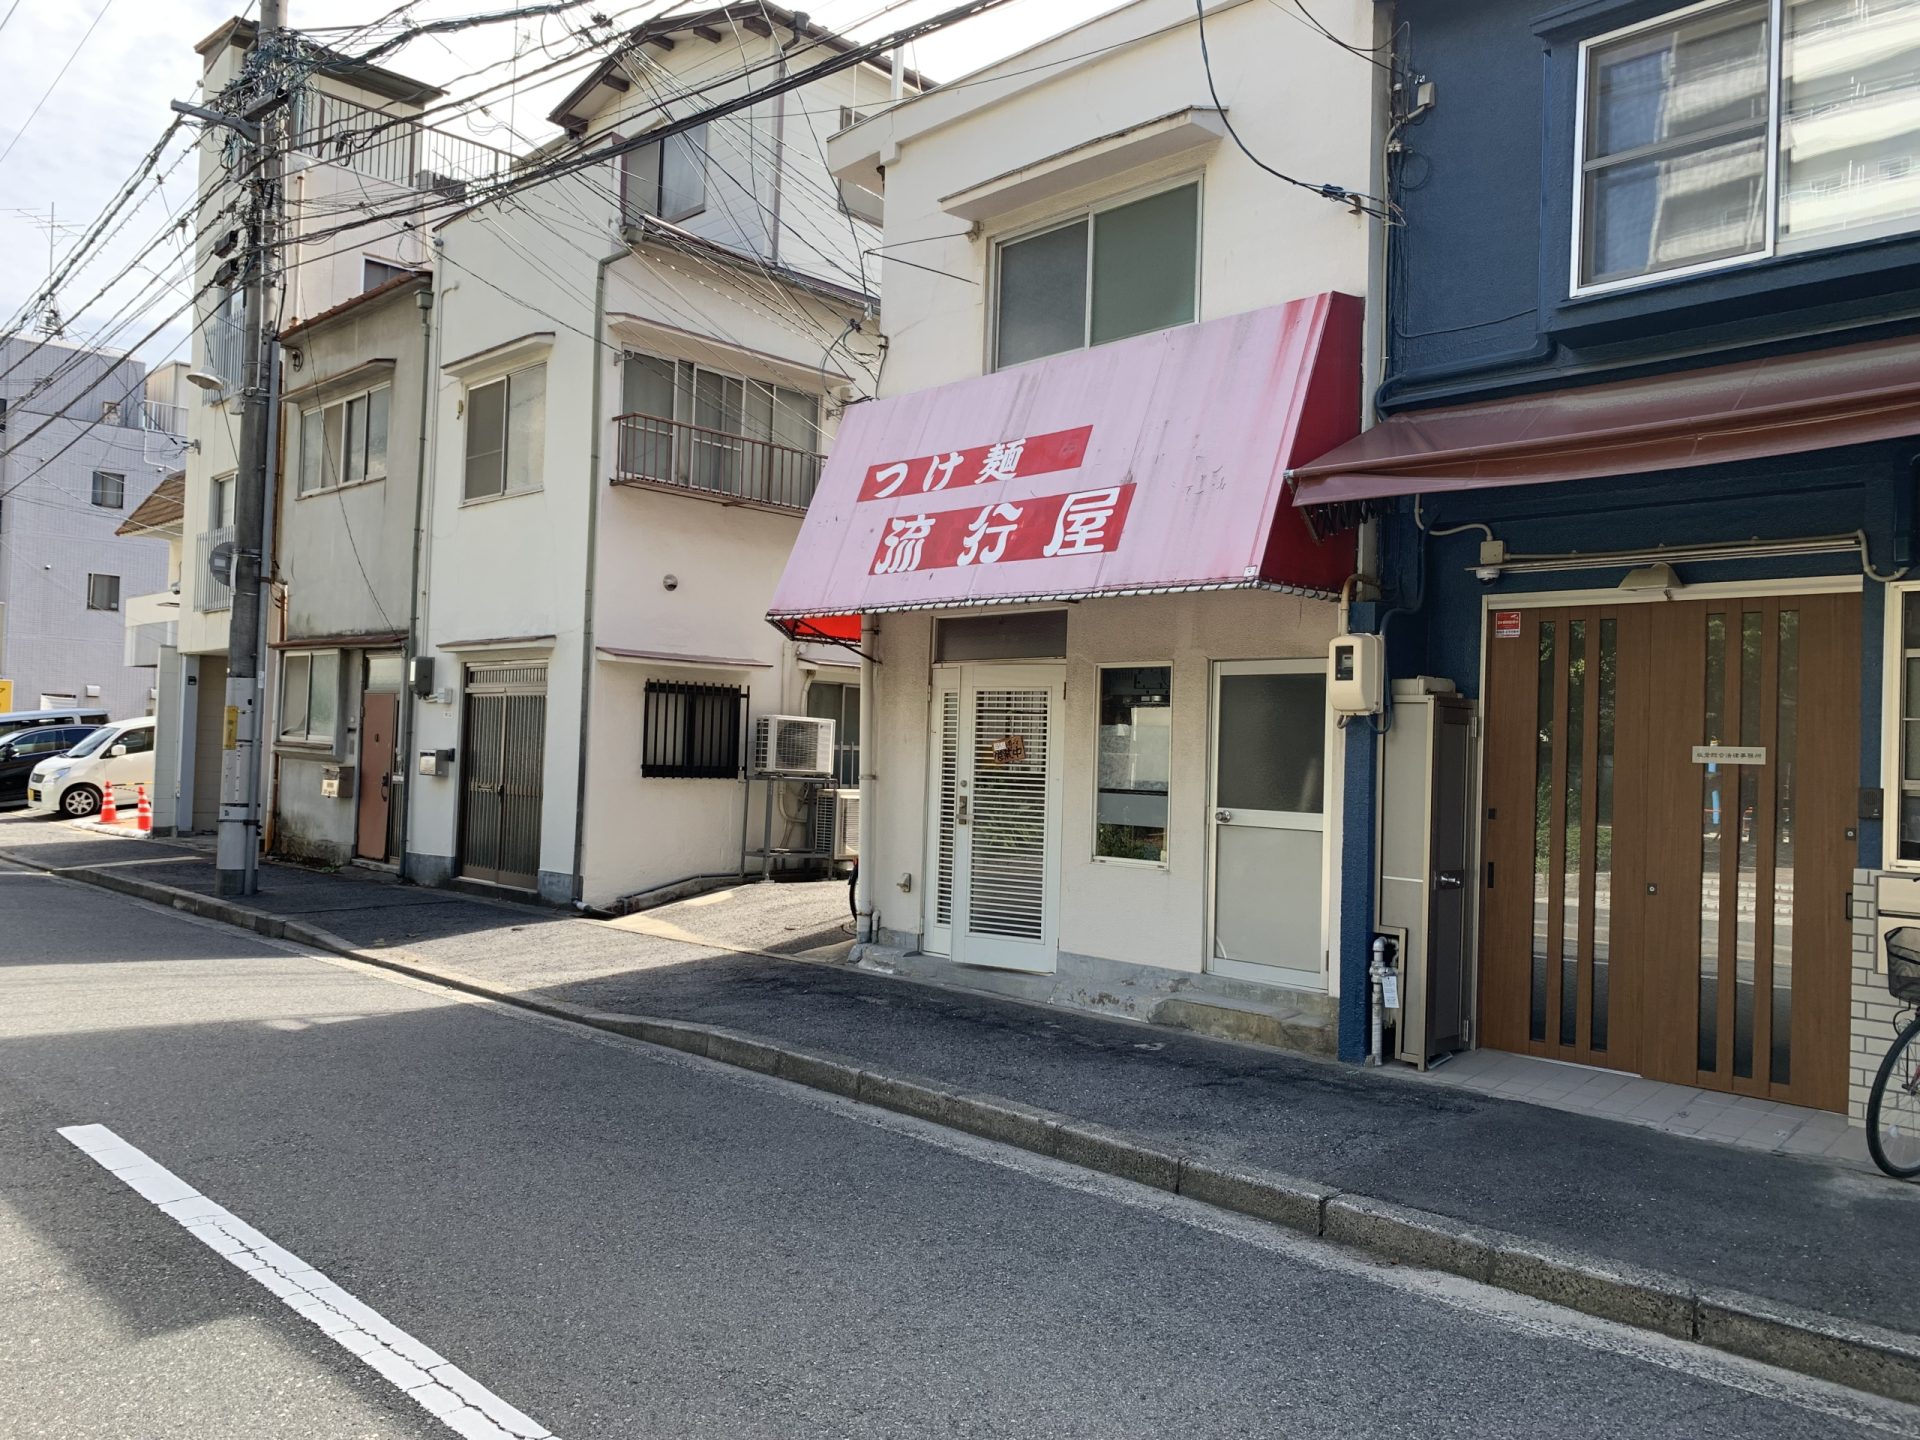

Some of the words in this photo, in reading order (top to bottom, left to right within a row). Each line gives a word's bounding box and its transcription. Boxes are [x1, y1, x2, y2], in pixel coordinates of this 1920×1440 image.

[874, 438, 1026, 498] つけ麺
[874, 487, 1121, 575] 流行屋
